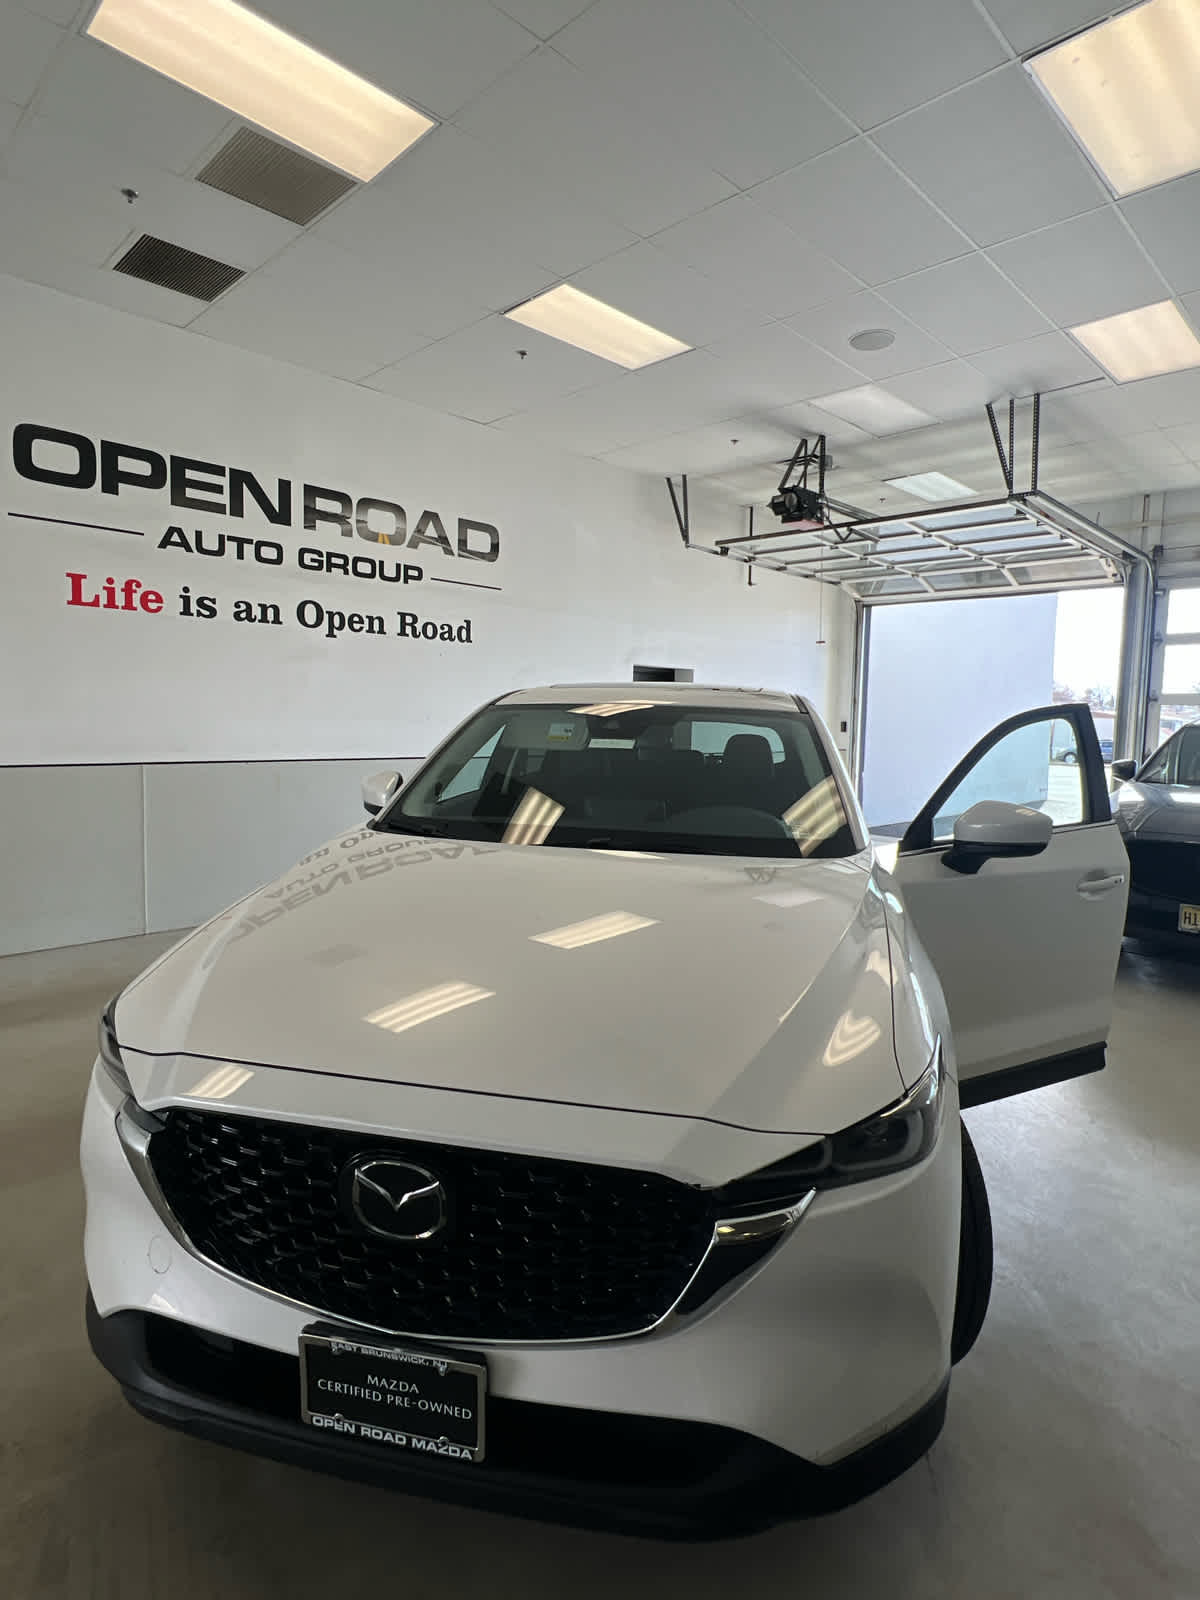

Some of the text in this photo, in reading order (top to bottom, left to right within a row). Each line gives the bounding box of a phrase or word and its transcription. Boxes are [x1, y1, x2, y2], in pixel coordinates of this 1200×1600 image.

[13, 423, 500, 563] OPEN ROAD
[157, 526, 424, 584] AUTO GROUP
[65, 572, 473, 644] Life is an Open Road
[317, 1378, 473, 1420] CERTIFIED PRE-OWNED
[367, 1374, 420, 1395] MAZDA
[311, 1415, 474, 1461] OPEN ROAD MAZDA
